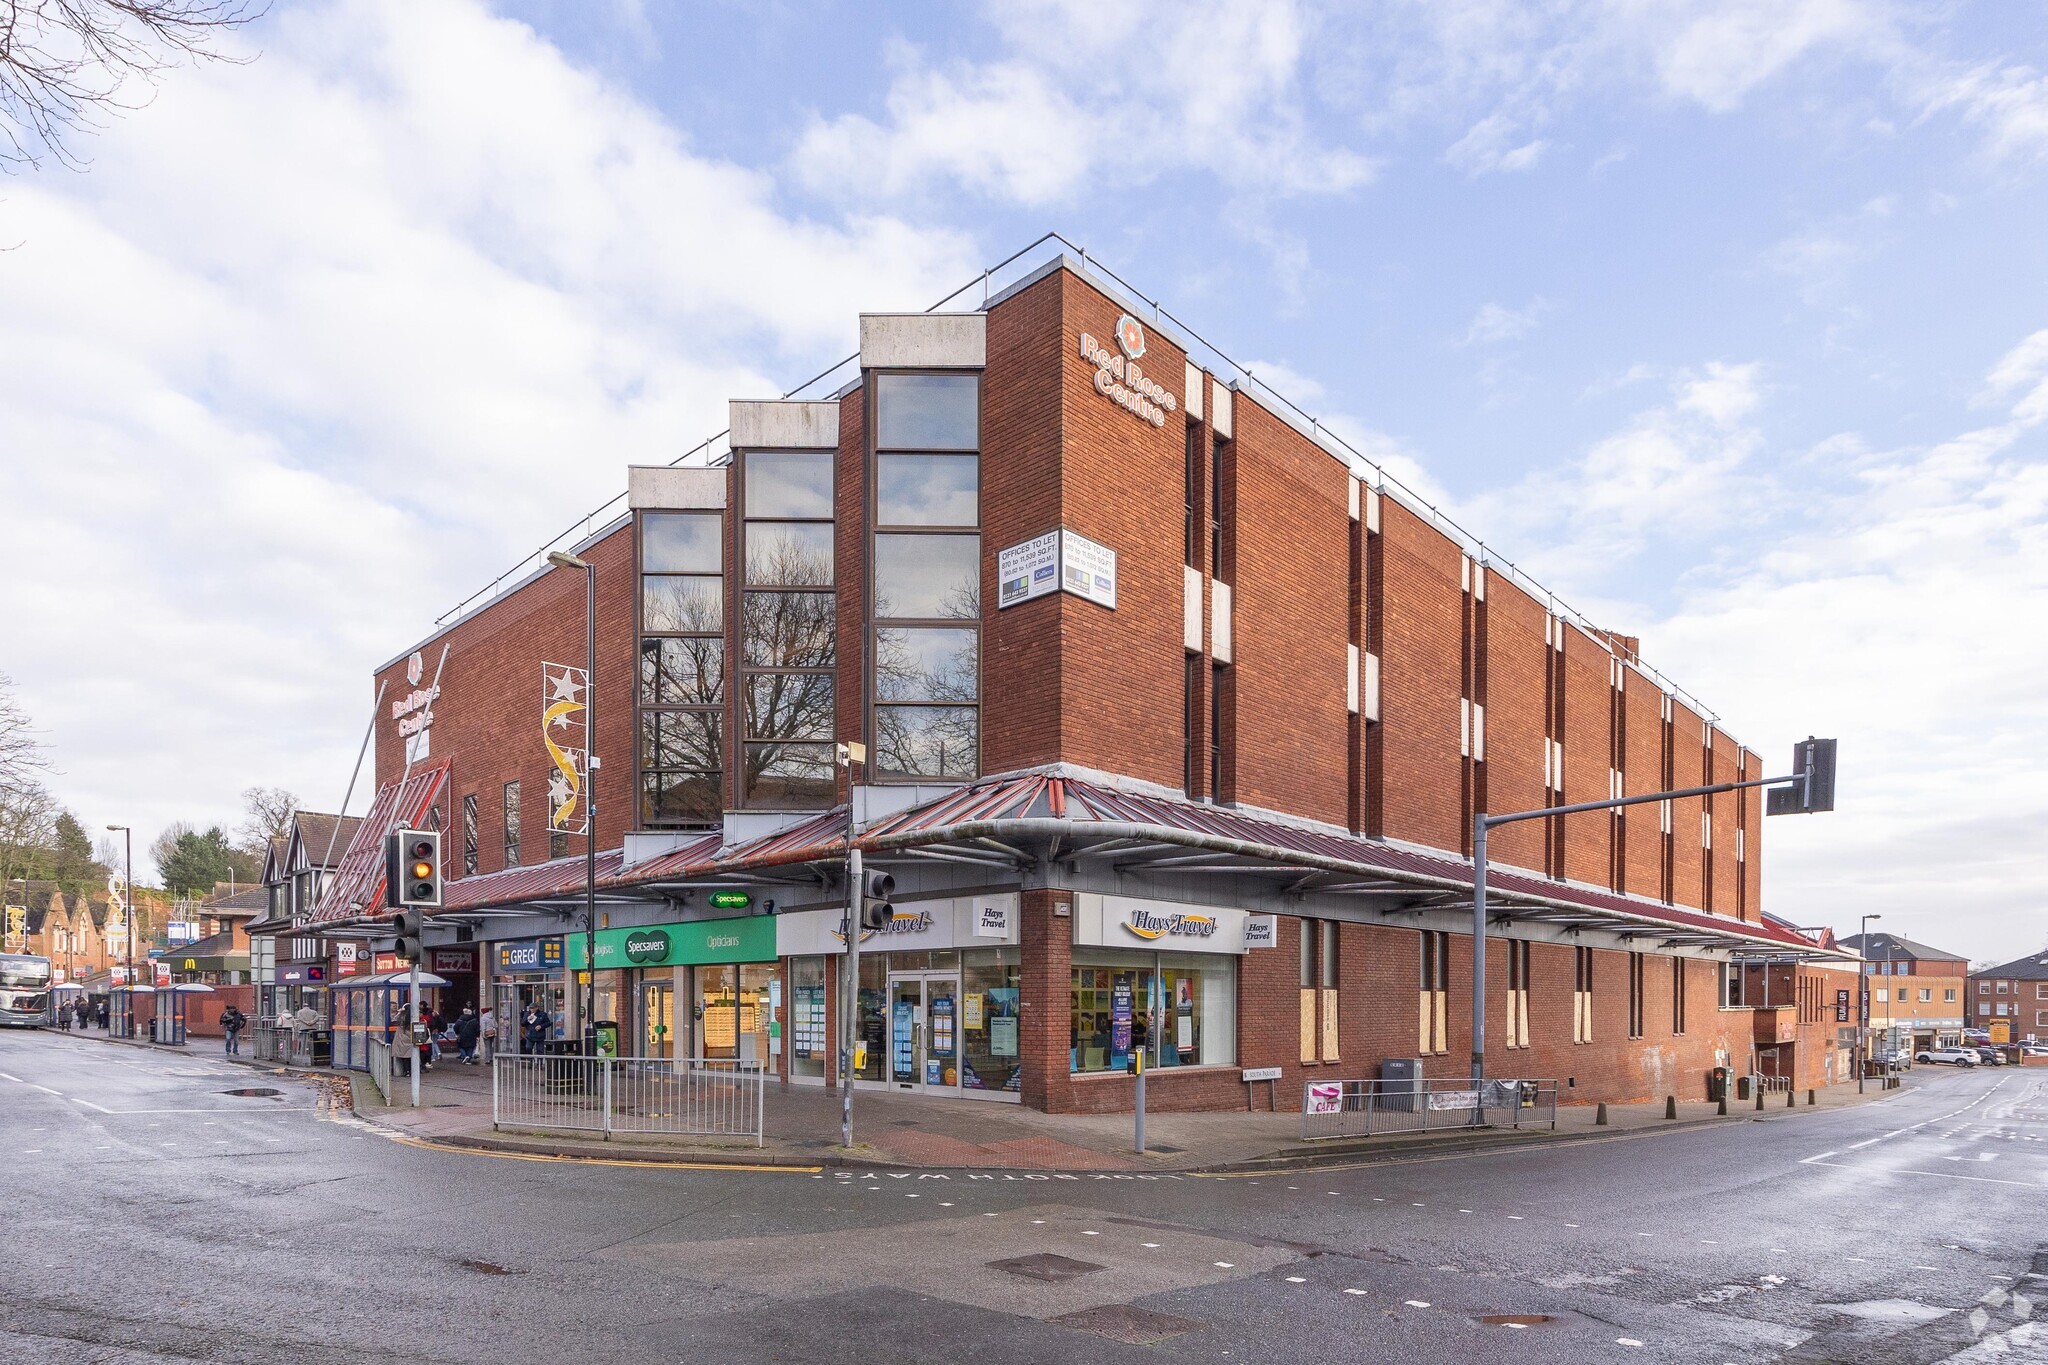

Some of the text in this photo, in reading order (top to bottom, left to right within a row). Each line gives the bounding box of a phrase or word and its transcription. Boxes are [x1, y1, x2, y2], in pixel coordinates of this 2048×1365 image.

[1080, 332, 1176, 411] Red Rose
[1094, 369, 1164, 428] Centre
[1002, 534, 1057, 560] OFFICES TO LET
[1065, 533, 1113, 559] OFFICES TO LET
[1001, 561, 1012, 570] 870
[392, 694, 413, 720] Red
[399, 711, 434, 738] Cente
[715, 894, 748, 904] Specsavers
[984, 908, 1003, 919] Hays
[981, 918, 1006, 928] Travel
[1134, 910, 1216, 935] Hays Travel
[1248, 923, 1268, 932] Hays
[707, 935, 739, 949] Opticians
[1246, 932, 1270, 940] Travel
[628, 940, 664, 954] Specsavers
[511, 949, 537, 964] GREG
[376, 957, 393, 970] SUTTON
[1316, 1102, 1336, 1112] CAFE
[834, 1172, 951, 1180] WAYS
[967, 1173, 1080, 1181] BOTH
